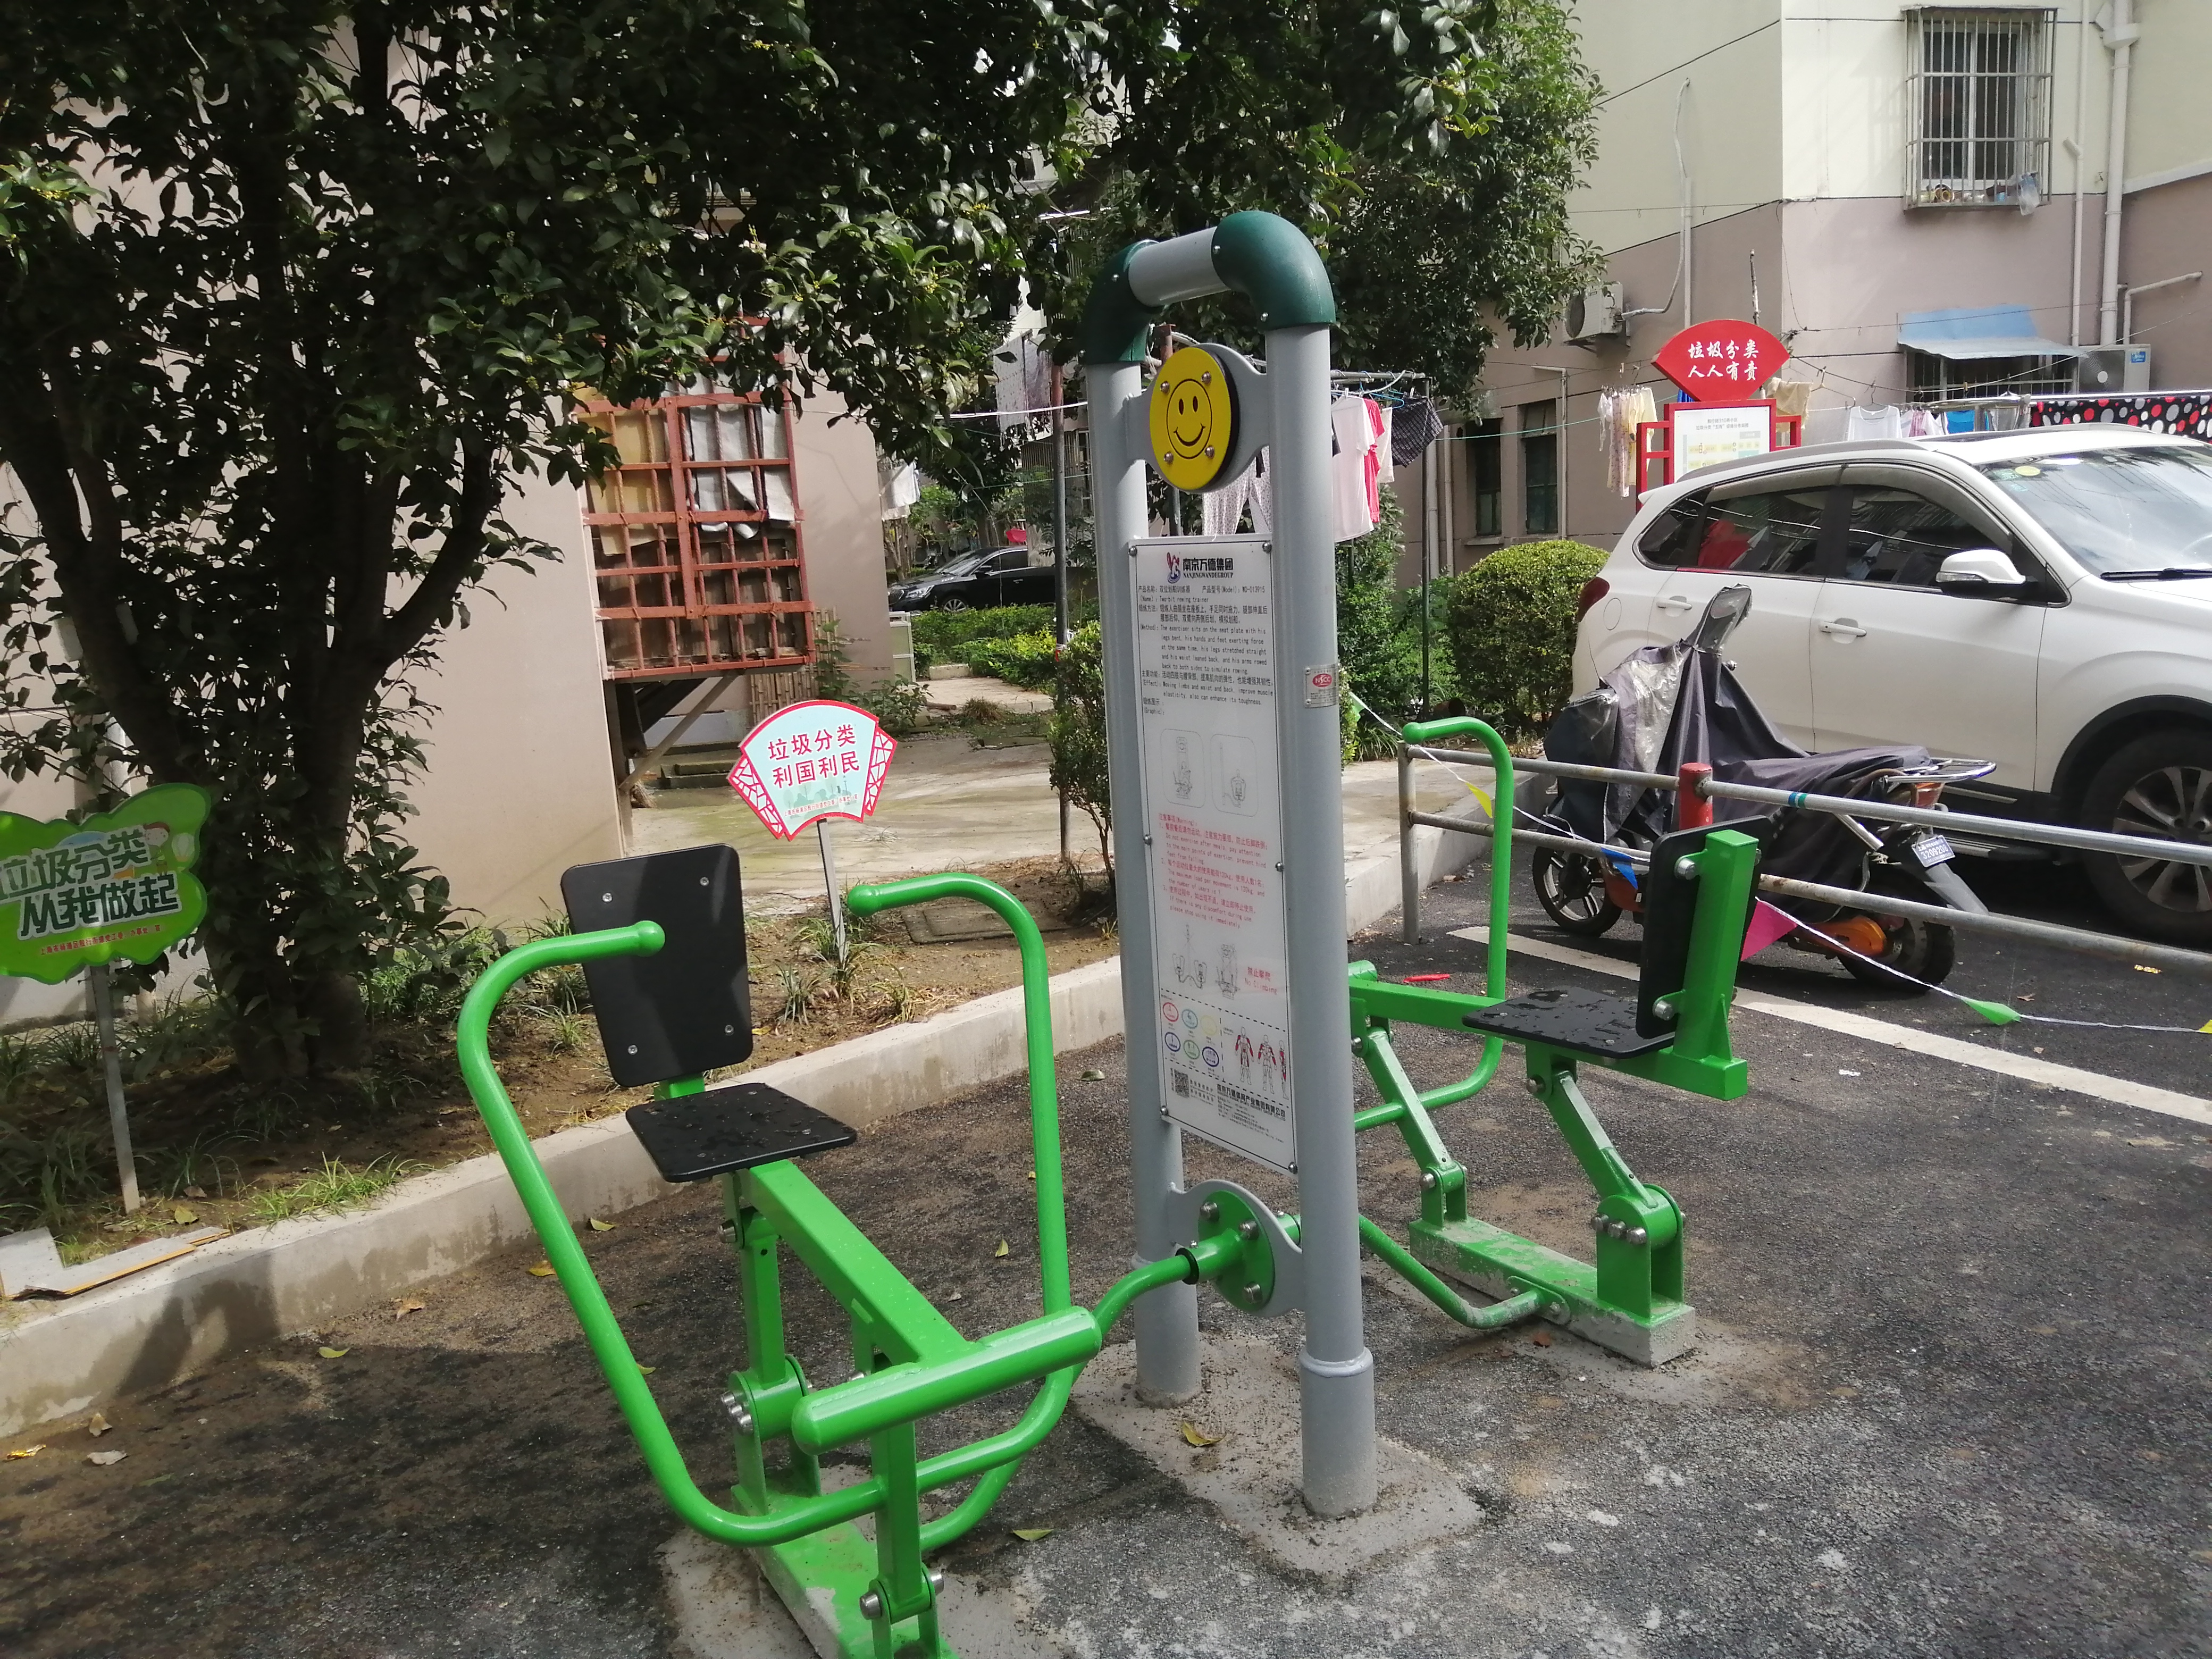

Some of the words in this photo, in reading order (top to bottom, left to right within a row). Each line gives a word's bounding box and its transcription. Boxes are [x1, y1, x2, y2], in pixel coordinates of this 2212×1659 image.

[1688, 339, 1759, 359] 垃圾分类
[1688, 360, 1759, 382] 人人有责
[1183, 557, 1234, 572] 南京万德集团
[767, 723, 857, 761] 垃圾分类
[772, 750, 860, 789] 利国利民
[0, 828, 149, 900] 垃圾分类
[21, 874, 179, 937] 从我做起
